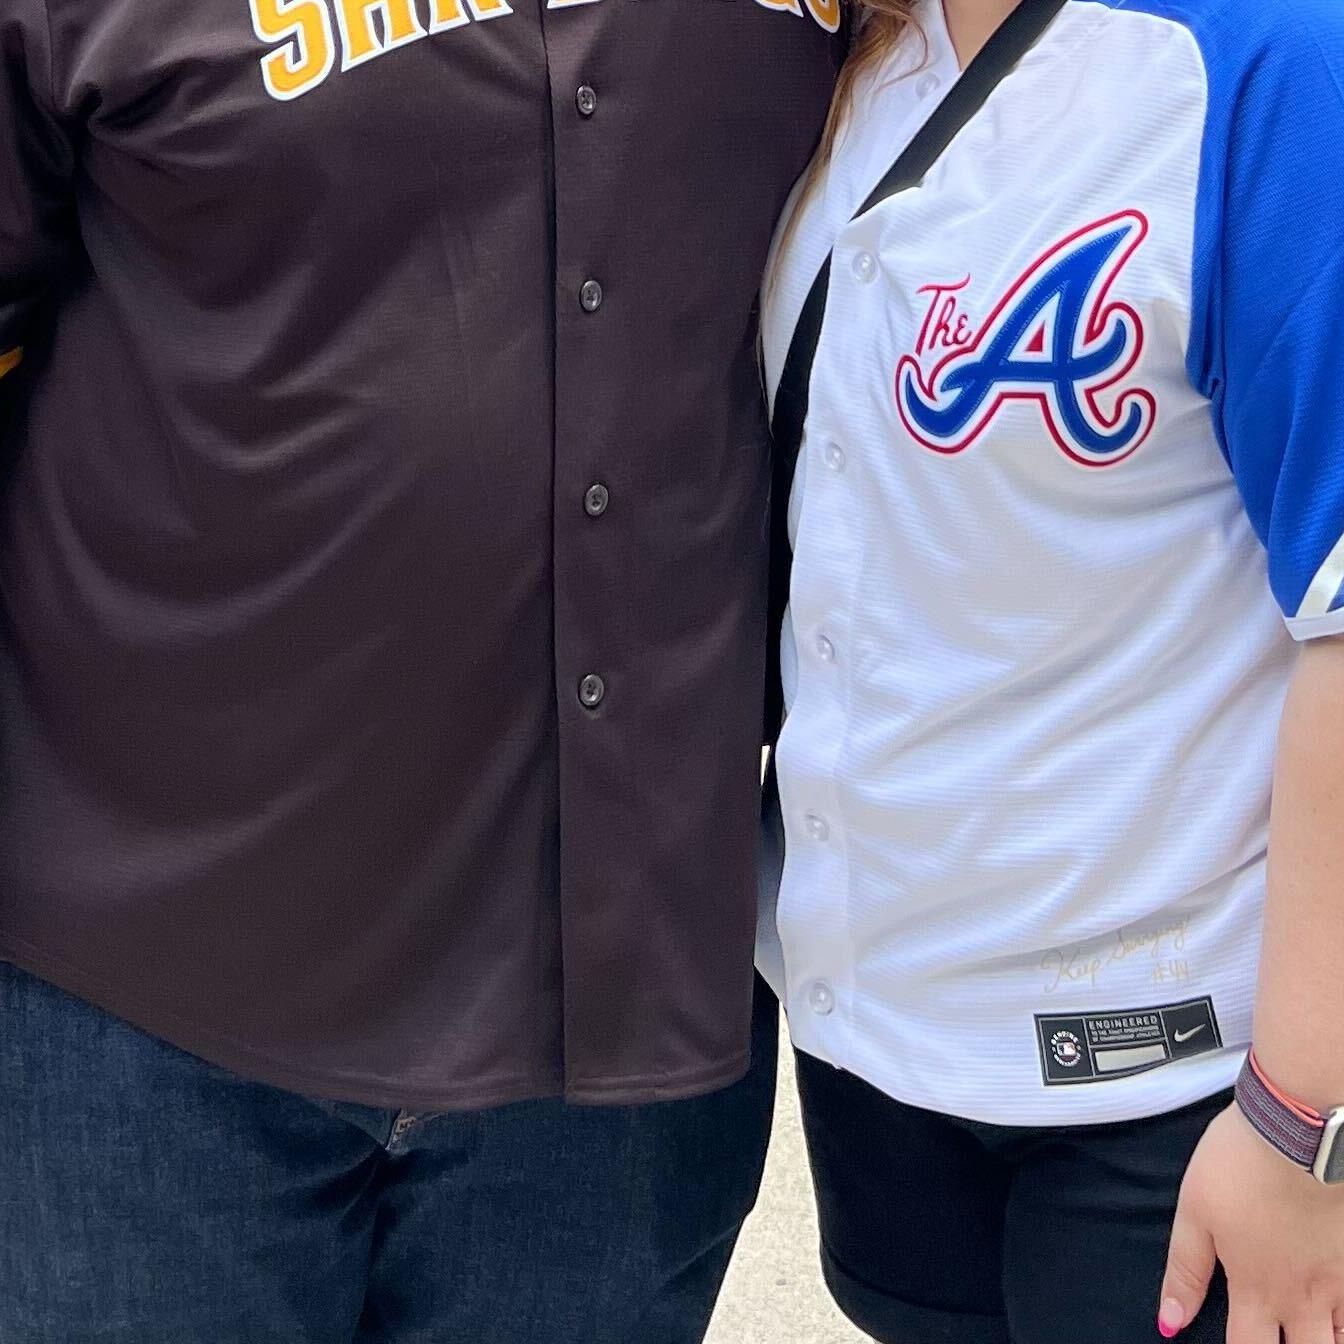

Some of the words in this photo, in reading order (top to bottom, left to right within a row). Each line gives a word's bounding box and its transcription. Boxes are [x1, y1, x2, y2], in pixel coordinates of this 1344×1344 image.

[894, 207, 1157, 468] A
[915, 271, 974, 358] The
[1088, 1014, 1158, 1030] ENGINEERED
